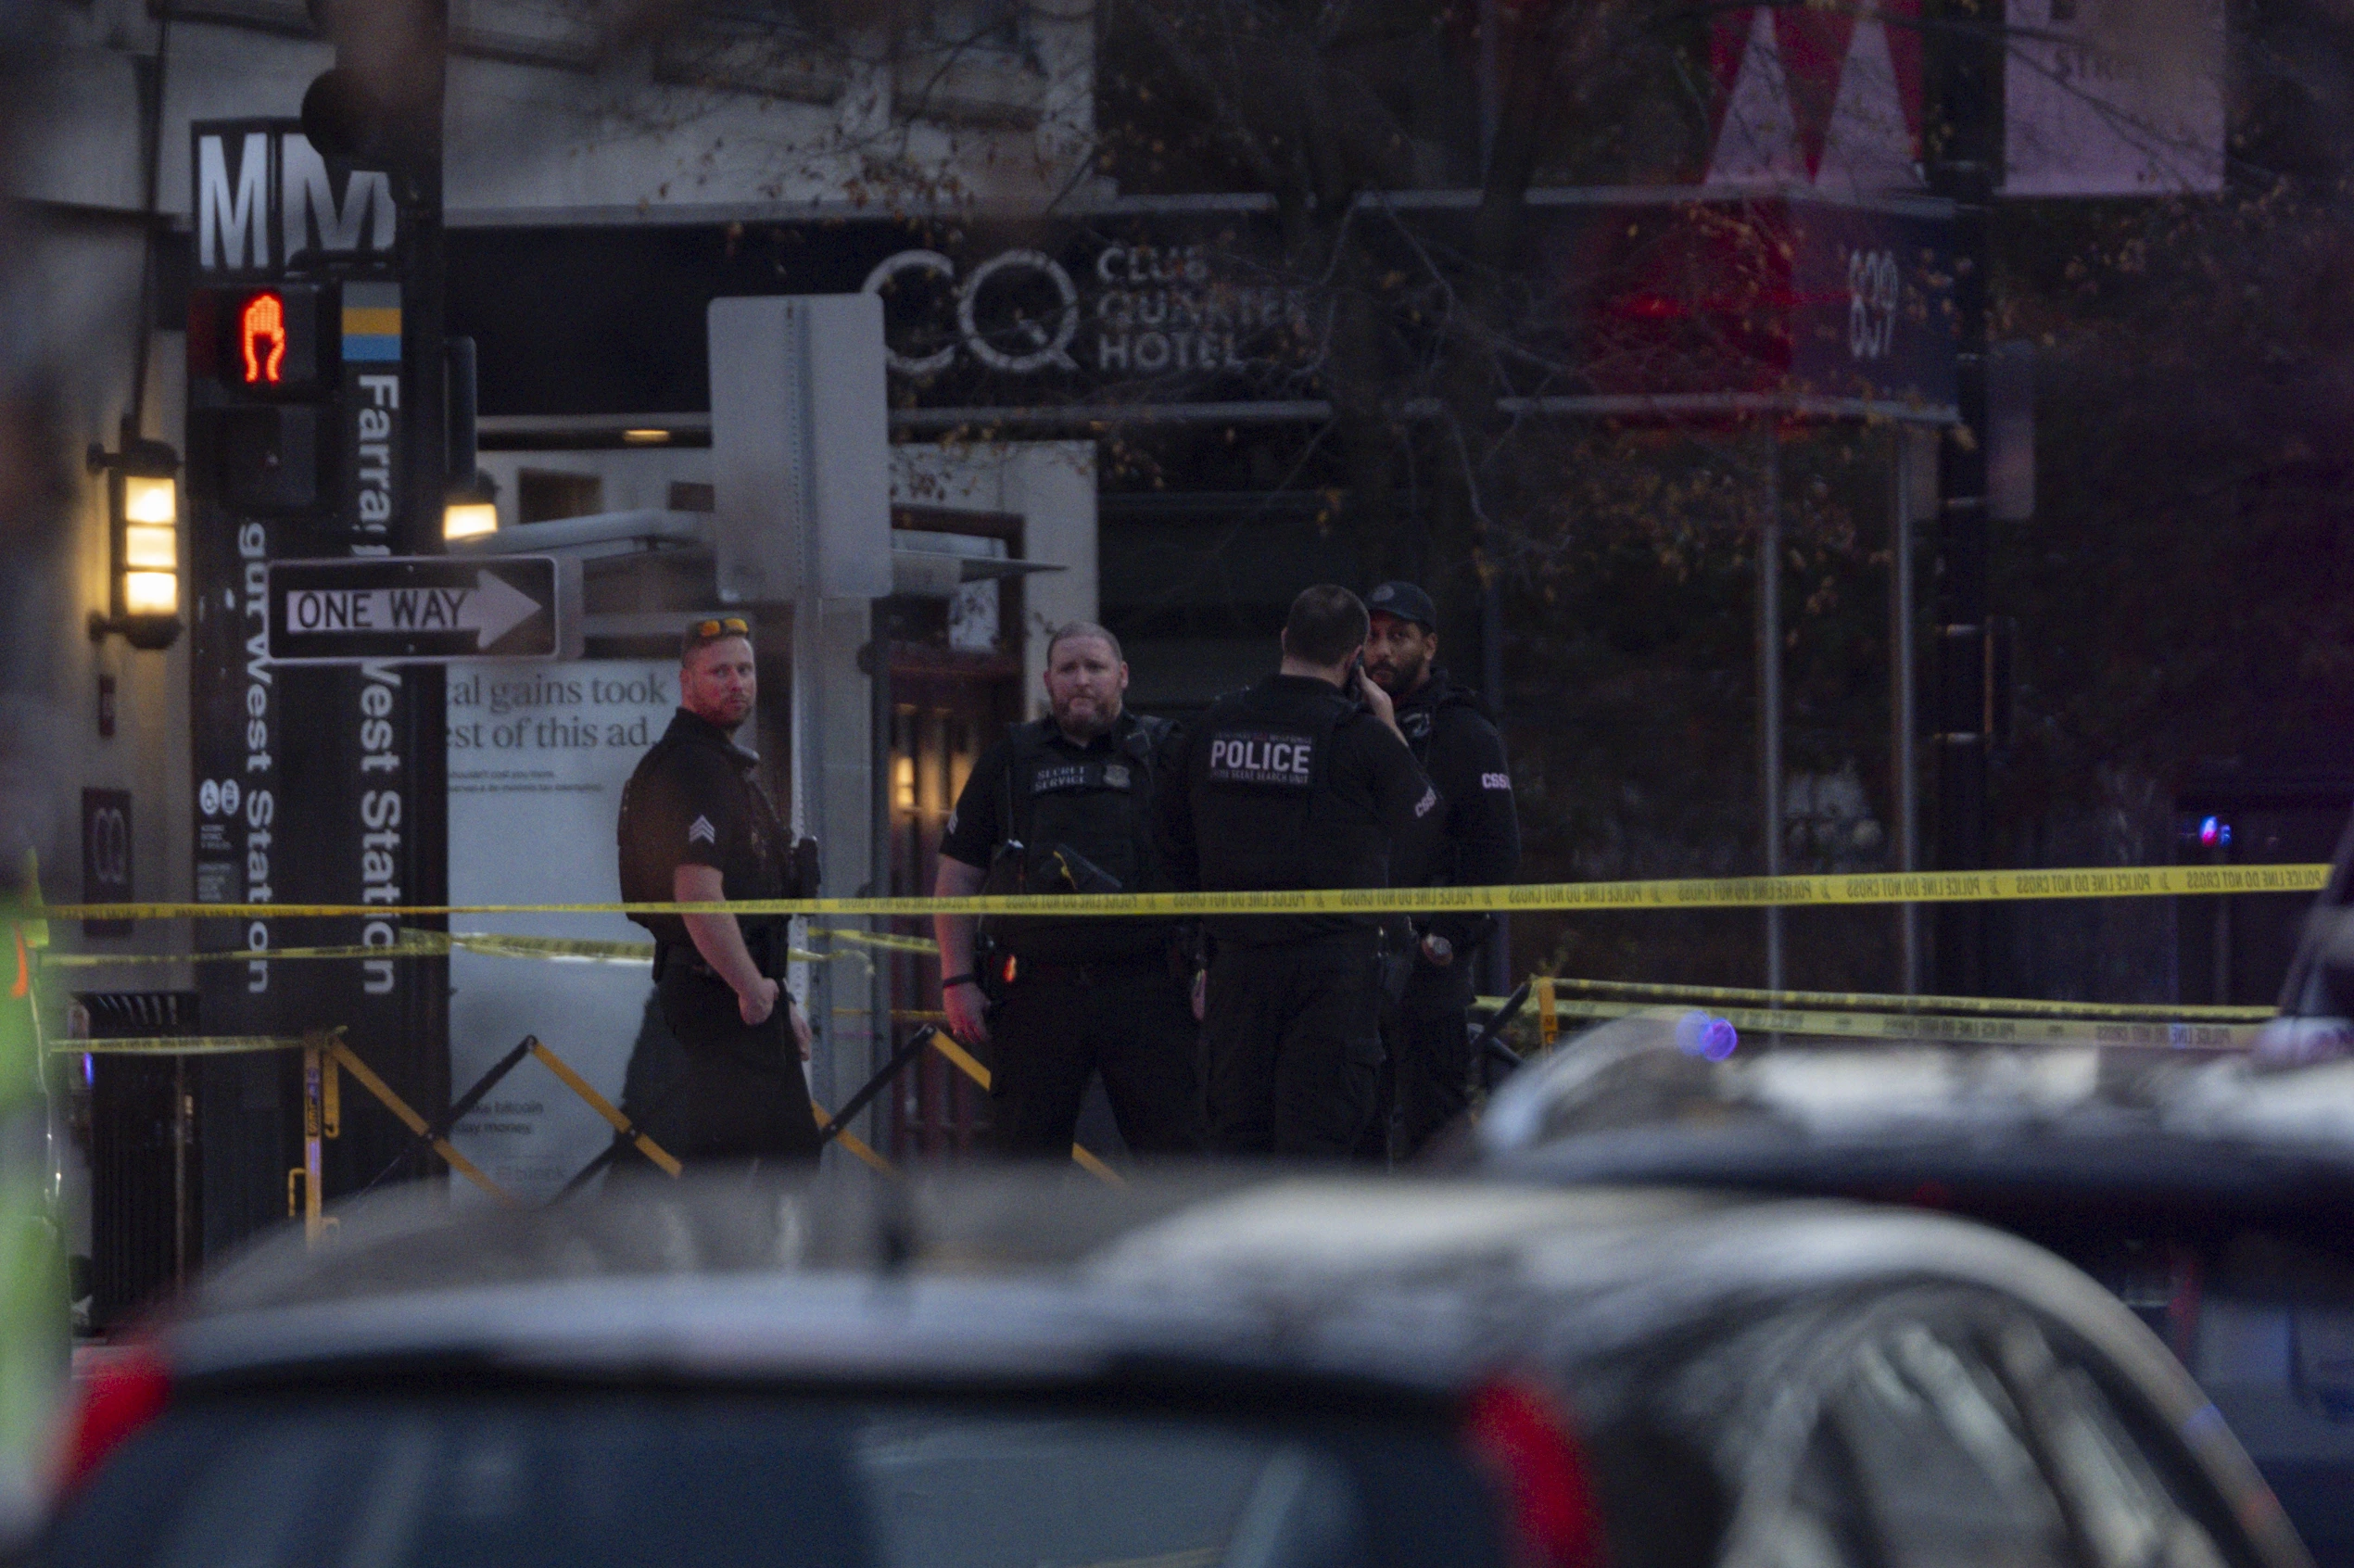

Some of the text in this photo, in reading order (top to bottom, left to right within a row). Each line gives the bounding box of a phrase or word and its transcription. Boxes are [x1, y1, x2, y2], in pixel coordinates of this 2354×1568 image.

[198, 133, 270, 270] M
[861, 247, 1081, 375] CQ
[1098, 331, 1246, 371] HOTEL
[297, 589, 468, 629] ONE WAY
[448, 674, 667, 714] al gains took
[492, 716, 532, 749] of
[538, 715, 599, 749] this
[1210, 740, 1311, 774] POLICE
[1034, 776, 1084, 792] SERVICE
[247, 790, 274, 993] Staton
